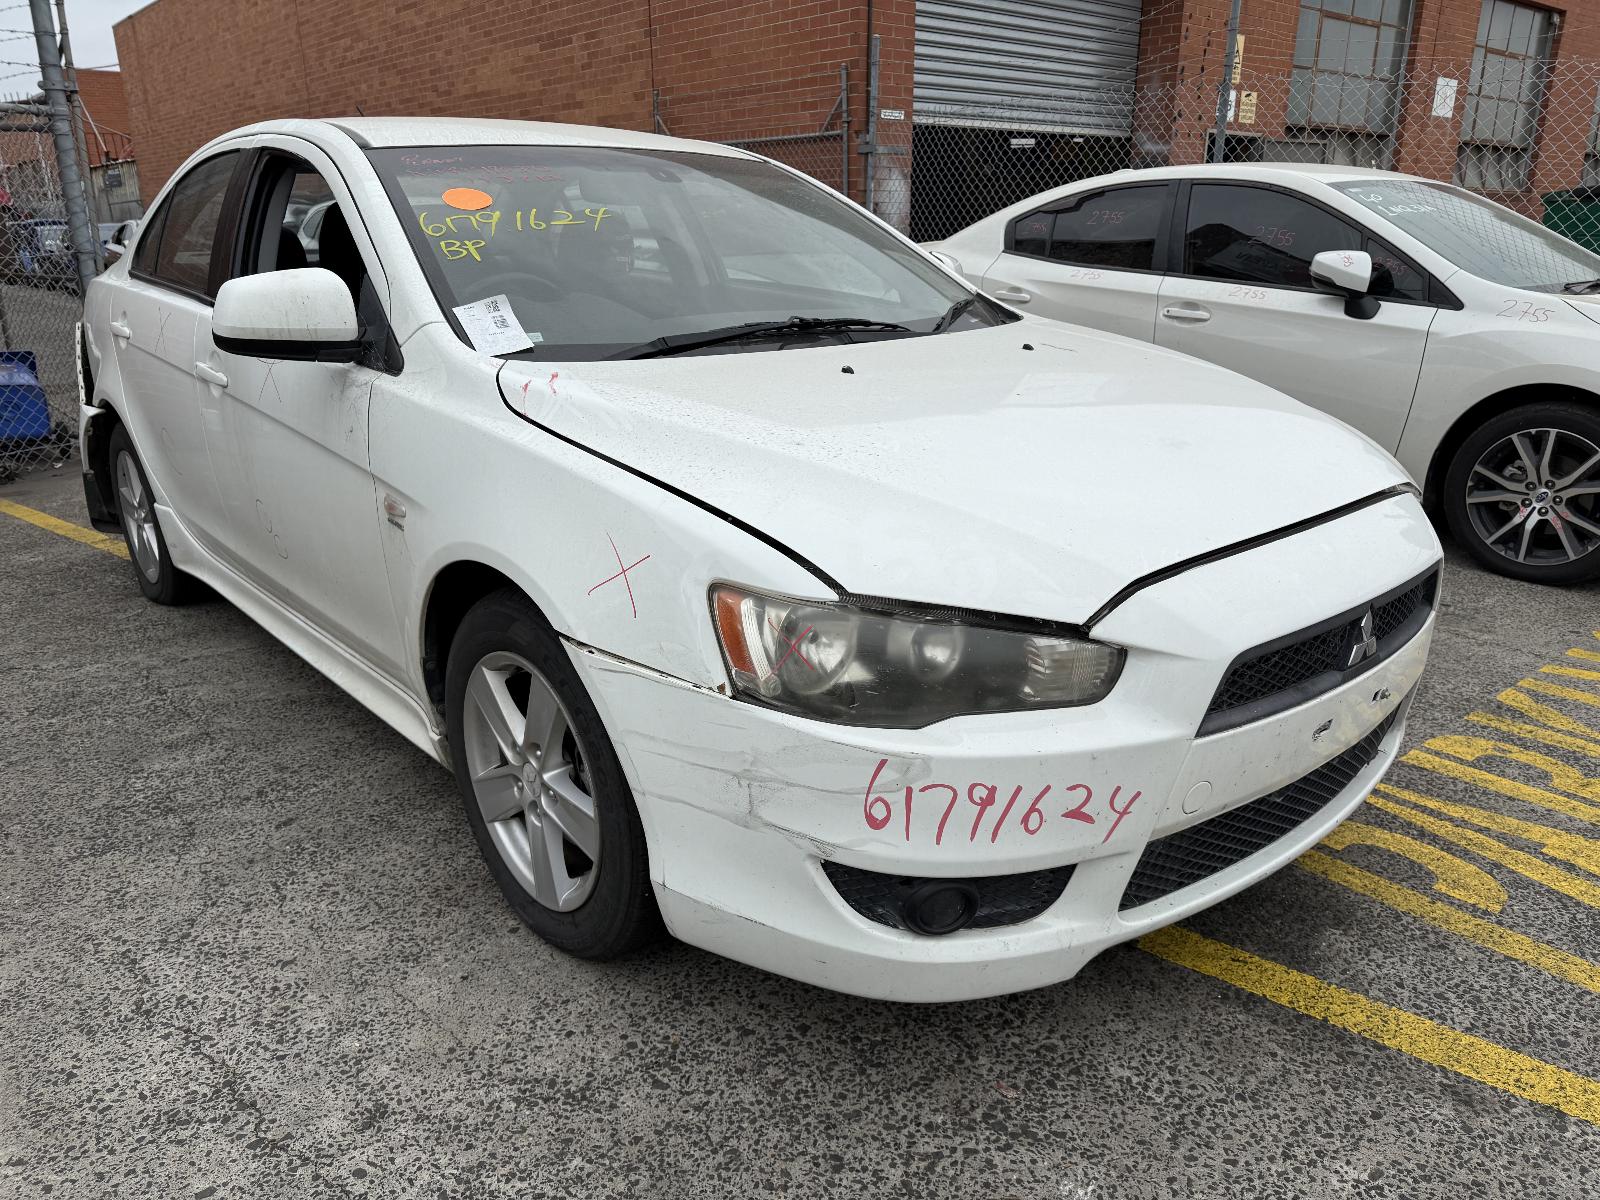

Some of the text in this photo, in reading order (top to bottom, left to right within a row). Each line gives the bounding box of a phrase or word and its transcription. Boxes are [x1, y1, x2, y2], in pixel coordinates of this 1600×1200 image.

[1086, 210, 1125, 225] 2755
[1248, 225, 1296, 248] 2755
[439, 239, 486, 262] BP
[1228, 286, 1267, 300] 2755
[1495, 299, 1556, 323] 2755
[864, 757, 1143, 846] 61791624
